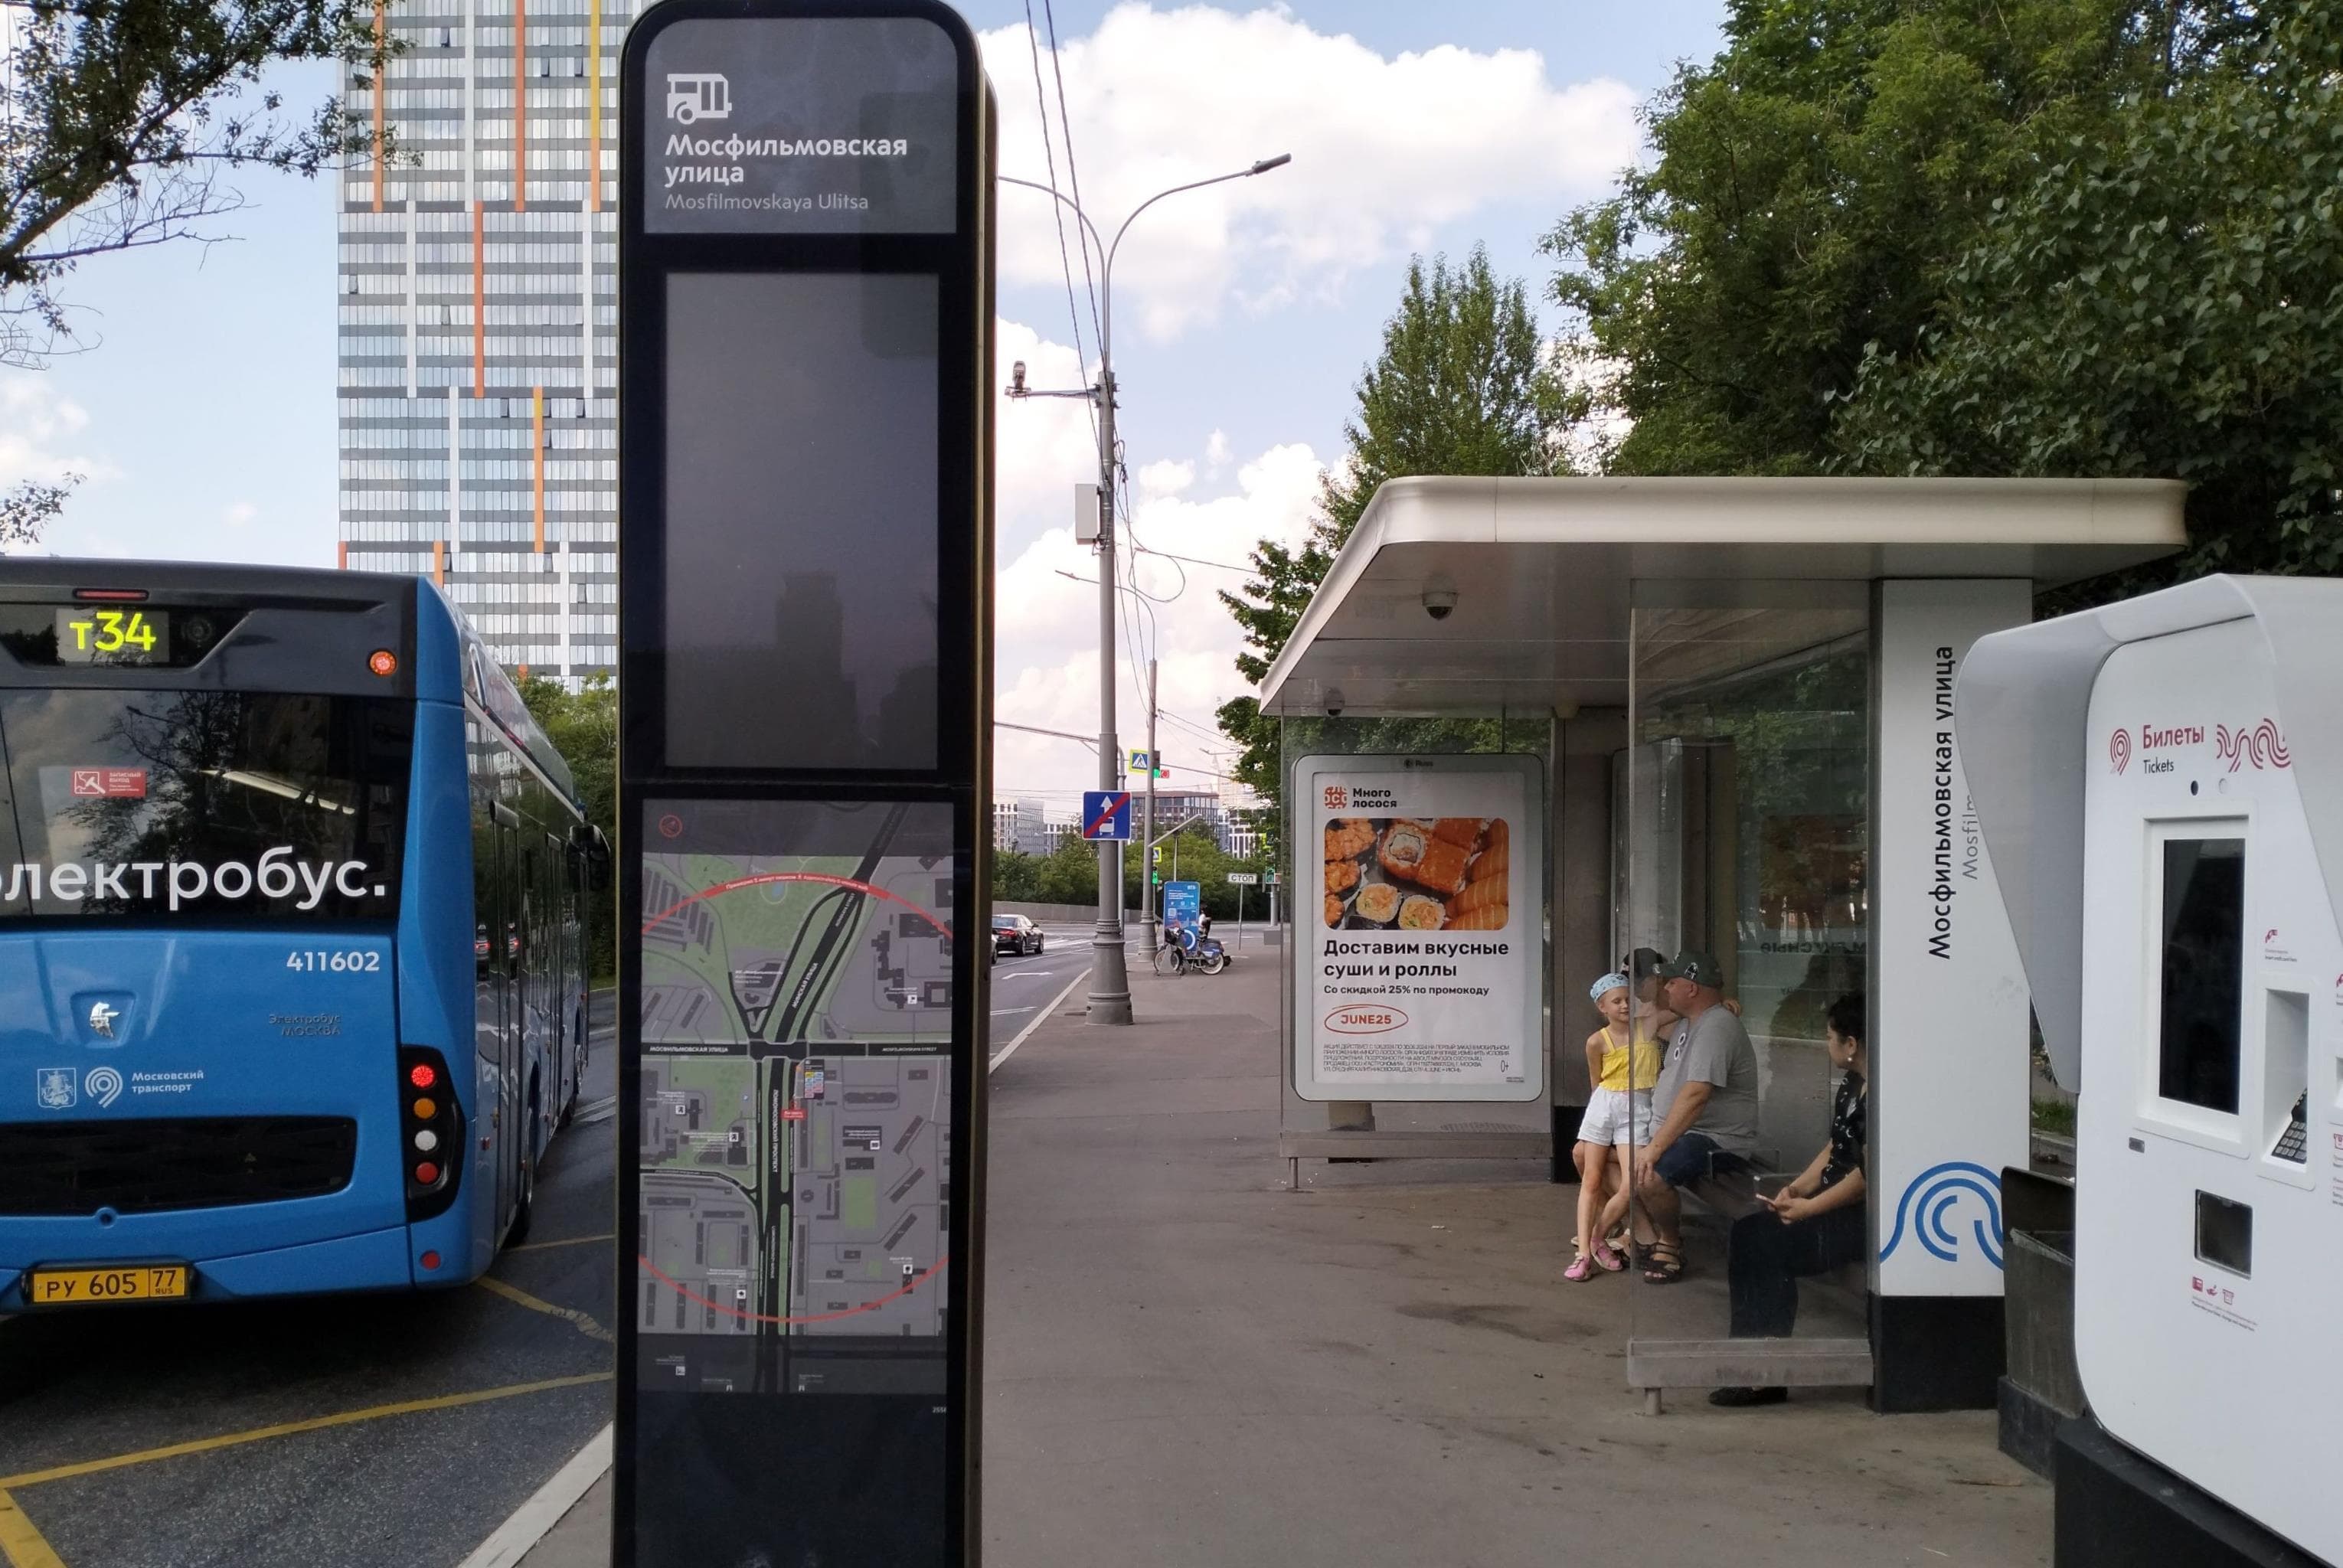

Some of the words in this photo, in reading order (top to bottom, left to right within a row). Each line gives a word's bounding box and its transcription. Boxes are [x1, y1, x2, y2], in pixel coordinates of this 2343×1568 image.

[665, 132, 907, 161] Мосфильмовская
[664, 165, 744, 188] улица
[665, 192, 812, 212] Mosfilmovskaya
[818, 192, 869, 210] Ulitsa
[1936, 646, 1956, 720] улица
[2142, 724, 2204, 750] Билеты
[2143, 756, 2175, 775] Tickets
[1352, 788, 1391, 798] Много
[1928, 731, 1956, 960] Мосфильмовская
[0, 845, 385, 911] лектробус.
[1324, 939, 1420, 957] Доставим
[1425, 942, 1509, 958] вкусные
[286, 952, 381, 972] 411602
[1324, 964, 1373, 979] суши
[1379, 965, 1390, 975] и
[1395, 964, 1457, 979] роллы
[1324, 985, 1338, 995] Со
[1341, 985, 1387, 996] скидкой
[1388, 985, 1410, 995] 25%
[1429, 987, 1489, 996] промокоду
[1340, 1014, 1392, 1024] JUNE25
[281, 1026, 341, 1036] МОСКВА
[132, 1070, 204, 1082] Московский
[132, 1084, 191, 1095] транспорт
[89, 1272, 137, 1296] 605
[152, 1269, 176, 1288] 77
